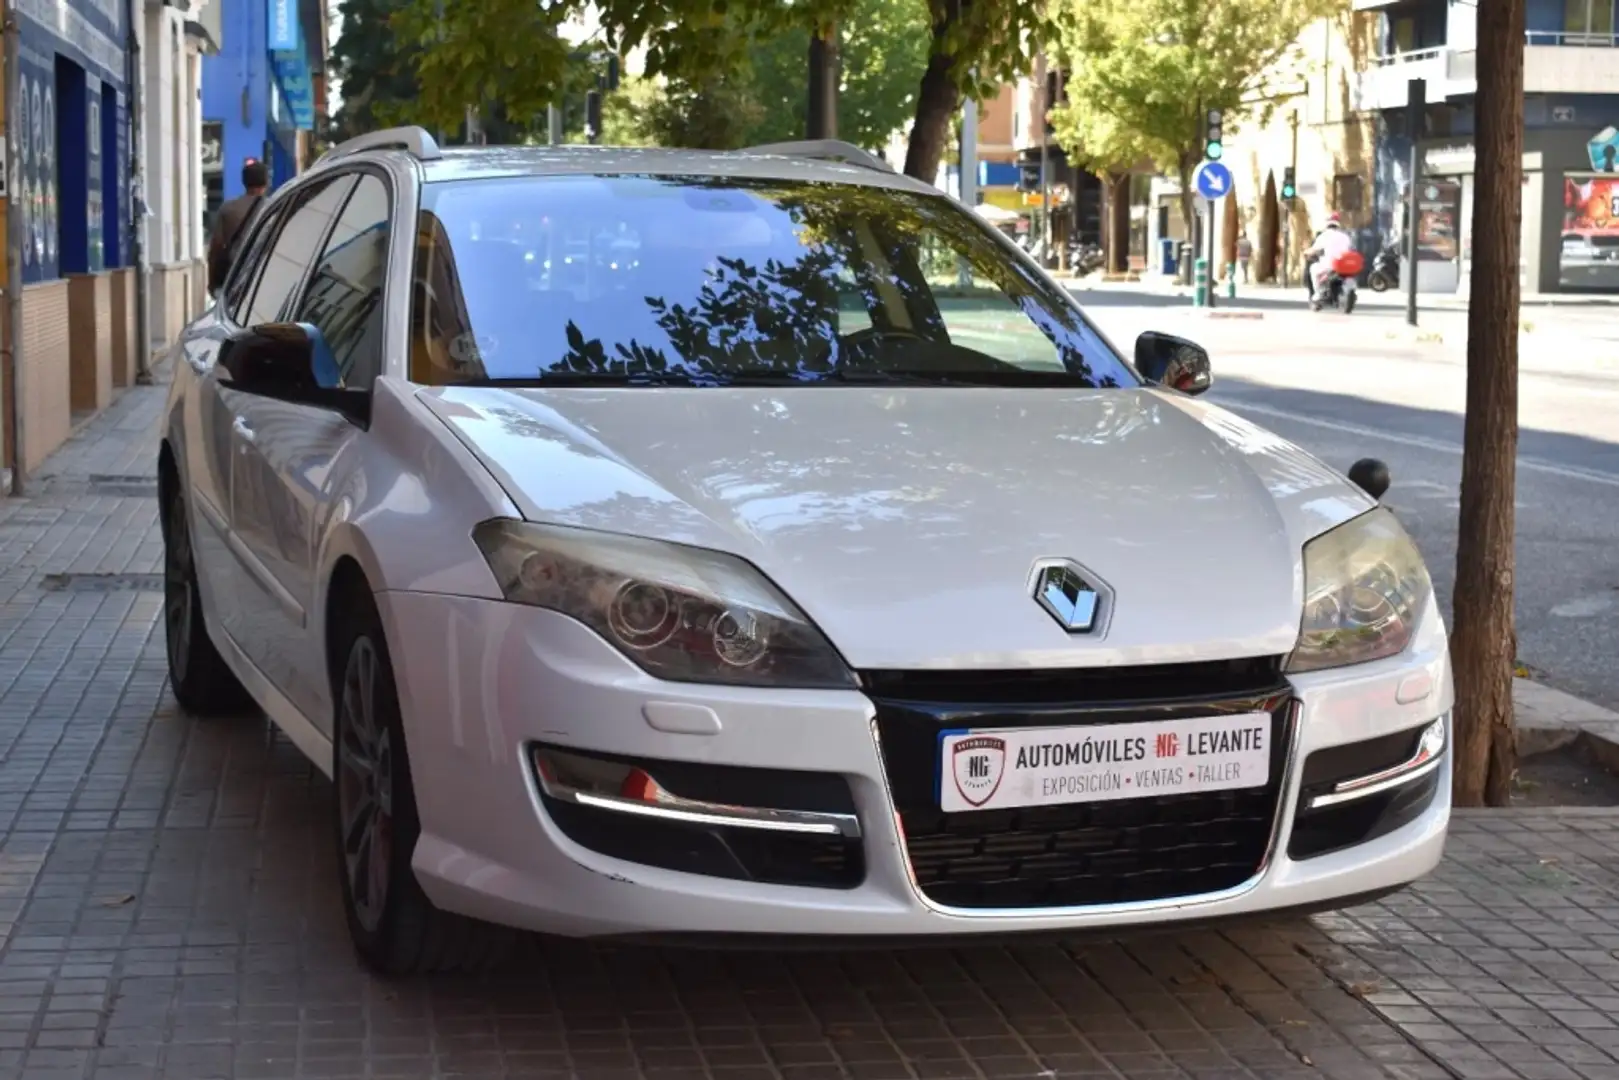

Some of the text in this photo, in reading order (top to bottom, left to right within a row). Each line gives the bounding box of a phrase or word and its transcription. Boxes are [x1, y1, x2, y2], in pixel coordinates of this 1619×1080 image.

[969, 755, 989, 778] NG
[1015, 727, 1263, 770] AUTOMÓVILES NG LEVANTE
[1042, 761, 1241, 797] EXPOSICIÓN VENTAS TALLER
